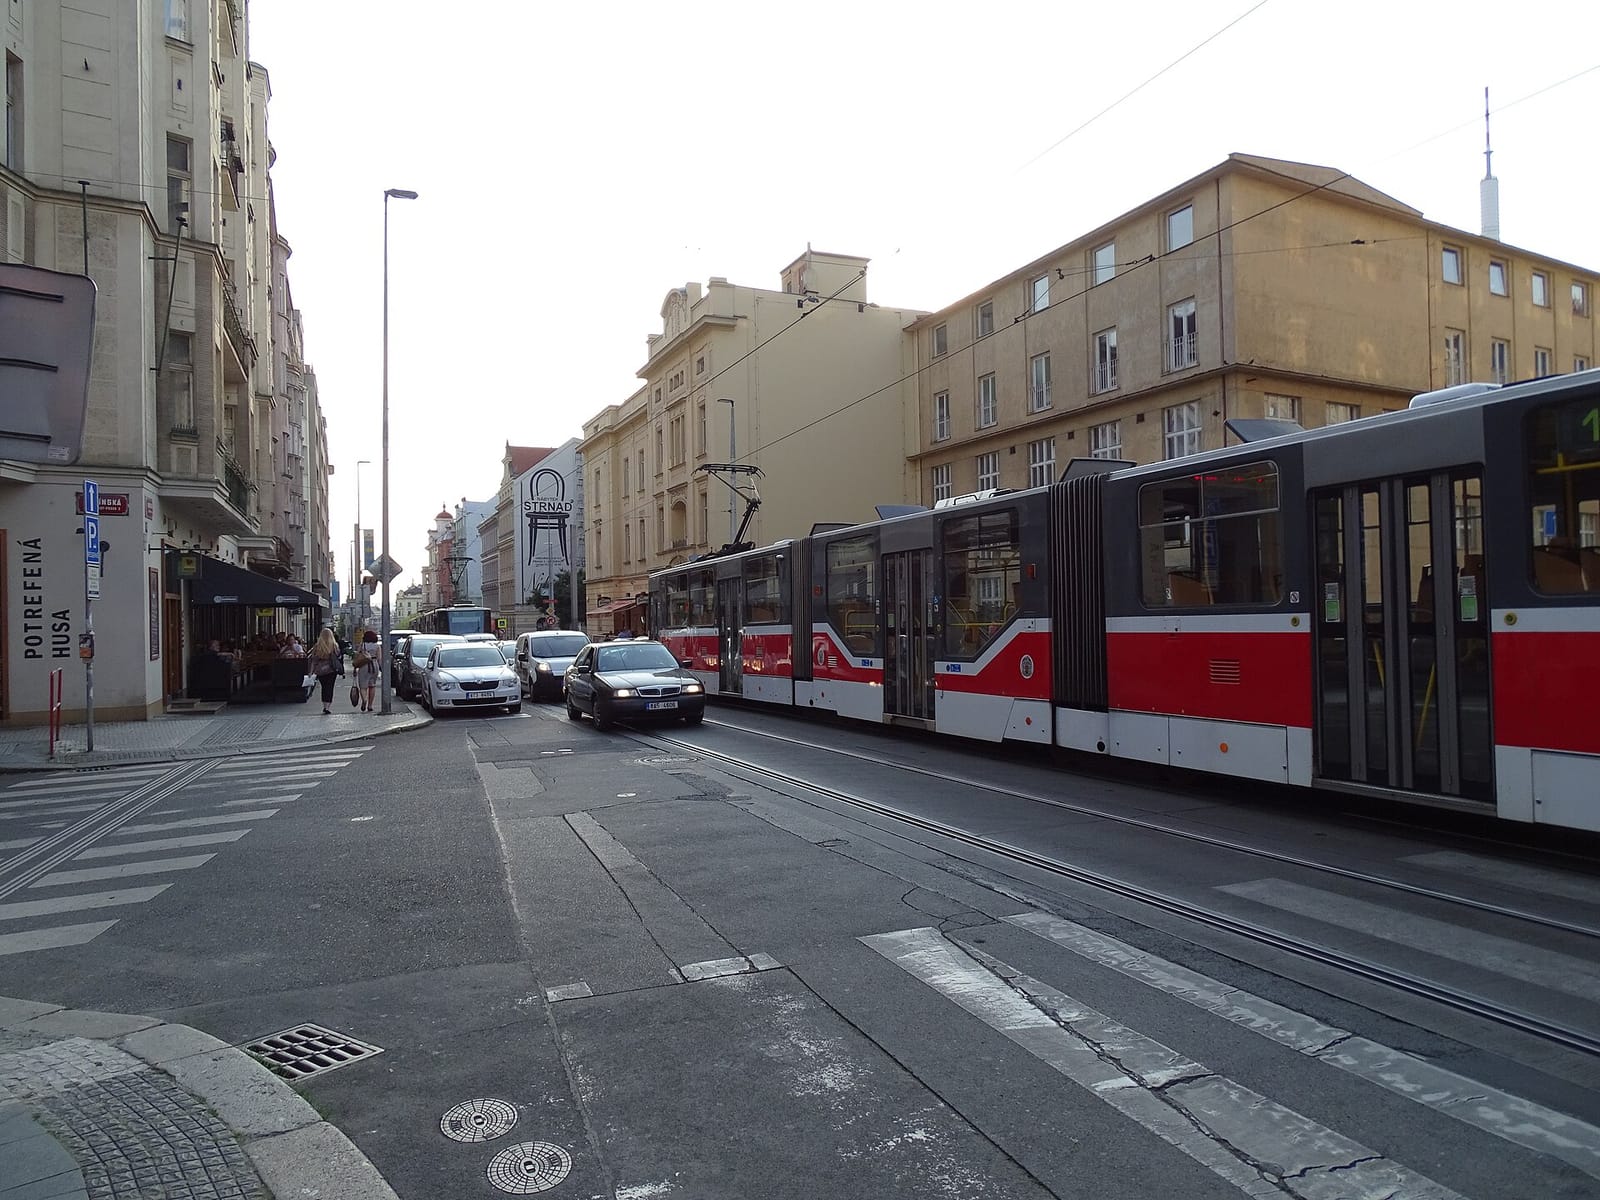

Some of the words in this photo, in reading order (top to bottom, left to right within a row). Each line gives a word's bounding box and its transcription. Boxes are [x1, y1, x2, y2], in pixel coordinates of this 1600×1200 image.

[523, 501, 573, 512] STRNAD
[16, 538, 43, 659] POTREFENÁ
[51, 609, 70, 658] HUSA
